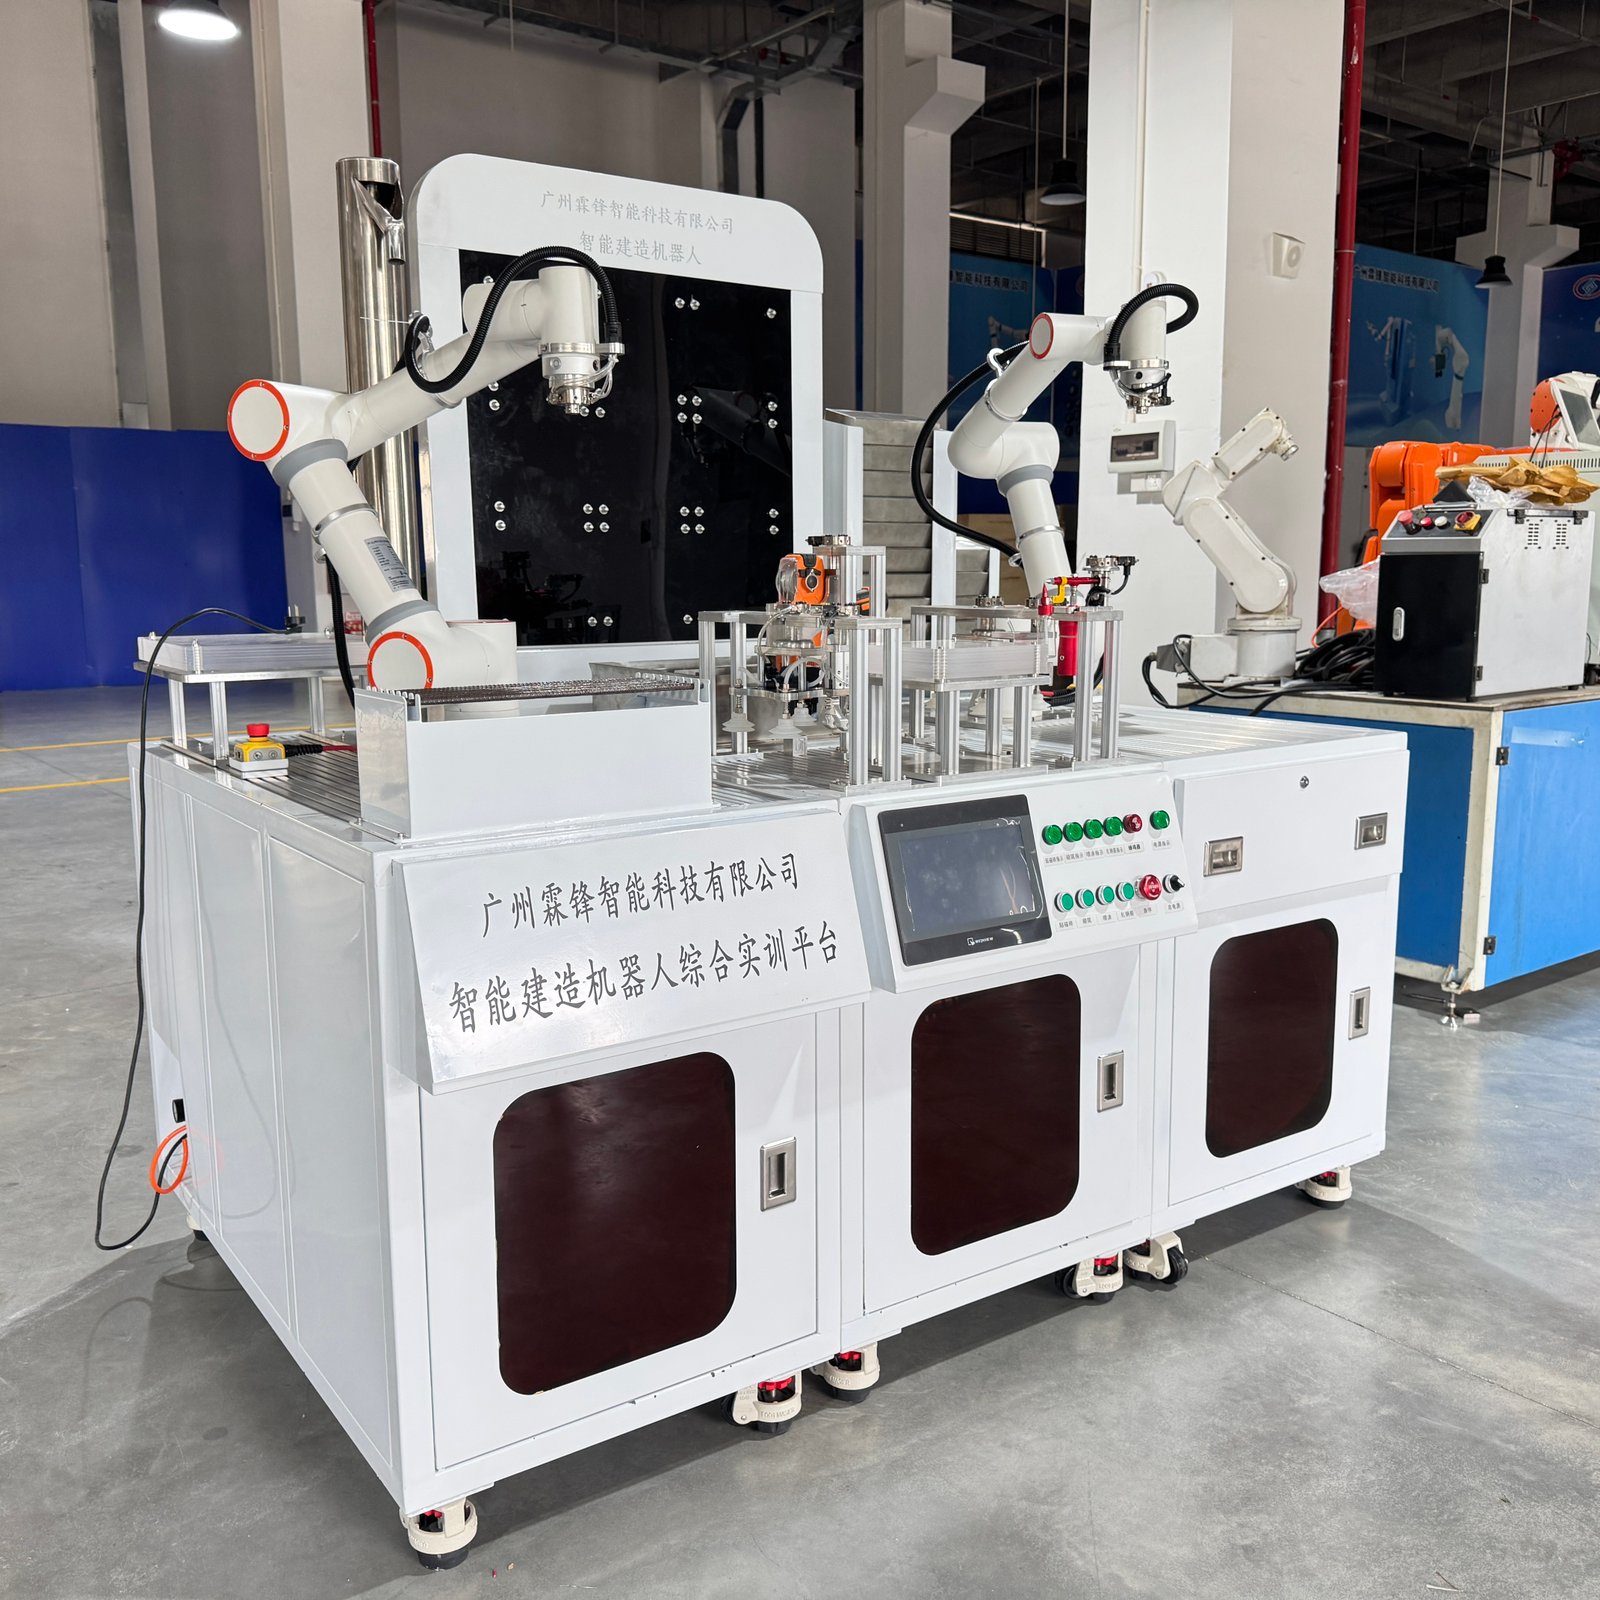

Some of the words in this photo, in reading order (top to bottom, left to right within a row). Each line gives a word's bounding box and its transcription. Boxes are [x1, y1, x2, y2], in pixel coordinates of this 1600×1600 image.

[541, 190, 734, 235] 广州霖锋智能科技有限公司
[579, 230, 702, 265] 智能建造机器人
[482, 853, 799, 938] 广州霖锋智能科技有限公司
[449, 920, 838, 1033] 智能建造机器人综合实训平台
